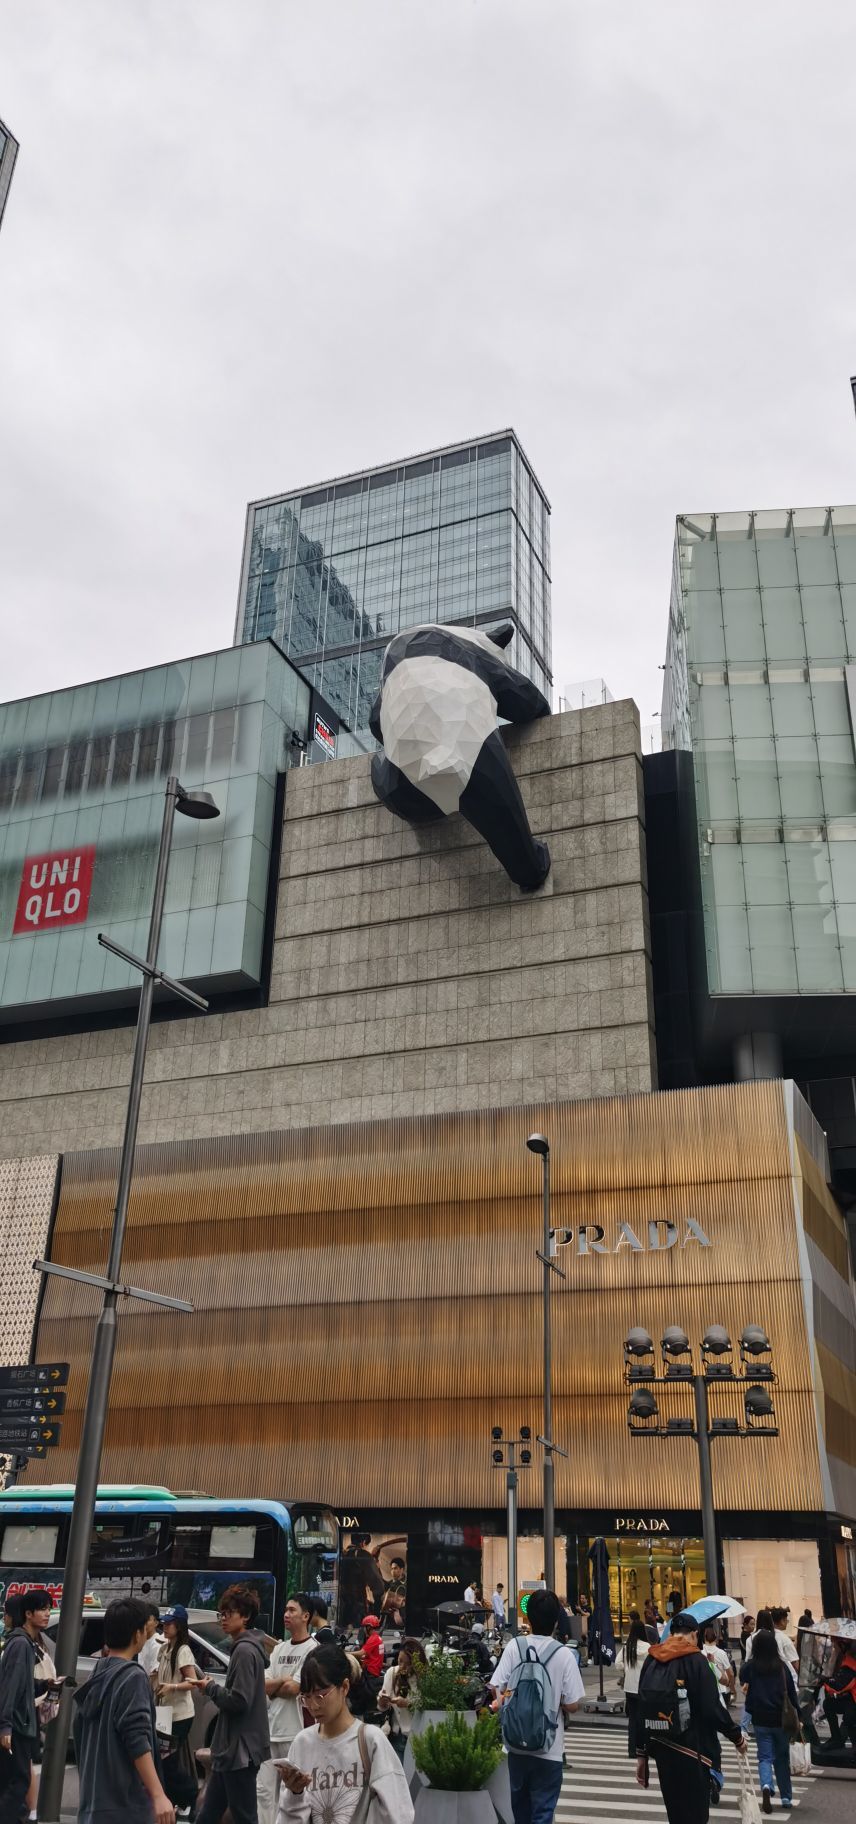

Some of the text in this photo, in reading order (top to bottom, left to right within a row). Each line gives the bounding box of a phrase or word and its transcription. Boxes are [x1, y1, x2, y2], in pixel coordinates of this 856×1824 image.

[30, 856, 81, 889] UNI
[25, 888, 81, 925] QLO
[548, 1217, 713, 1257] PRADA
[615, 1518, 670, 1531] PRADA
[428, 1575, 460, 1583] PRADA
[645, 1719, 669, 1730] PUMA
